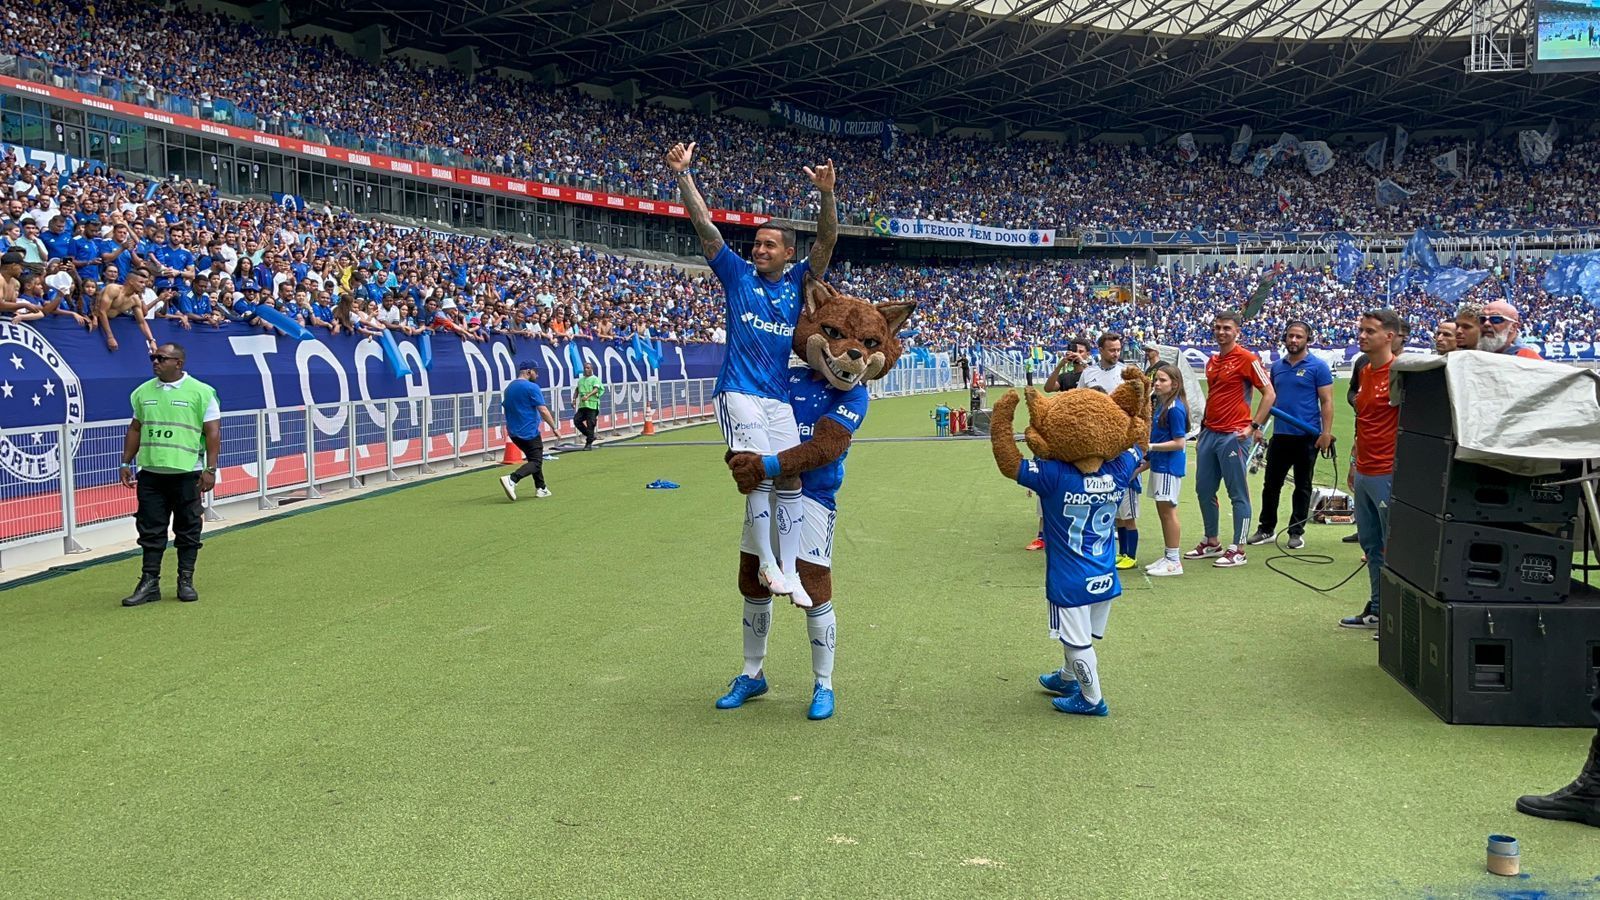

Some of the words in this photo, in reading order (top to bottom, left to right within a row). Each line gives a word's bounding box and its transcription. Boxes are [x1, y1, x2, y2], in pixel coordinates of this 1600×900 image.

[794, 109, 825, 132] BARRA
[829, 118, 841, 134] DO
[844, 120, 884, 135] CRUZEIRO
[201, 123, 229, 137] BRAHMA
[253, 134, 280, 148] BRAHMA
[302, 143, 327, 158] BRAHMA
[348, 152, 371, 167] BRAHMA
[391, 160, 413, 174] BRAHMA
[431, 167, 453, 180] BRAHMA
[471, 174, 491, 187] BRAHMA
[902, 223, 910, 234] O
[912, 223, 965, 238] INTERIOR
[968, 228, 992, 241] TEM
[995, 232, 1027, 243] DONO
[228, 334, 433, 442] TOCA
[462, 340, 518, 417] DA
[148, 429, 174, 439] 510
[1090, 578, 1110, 592] BH
